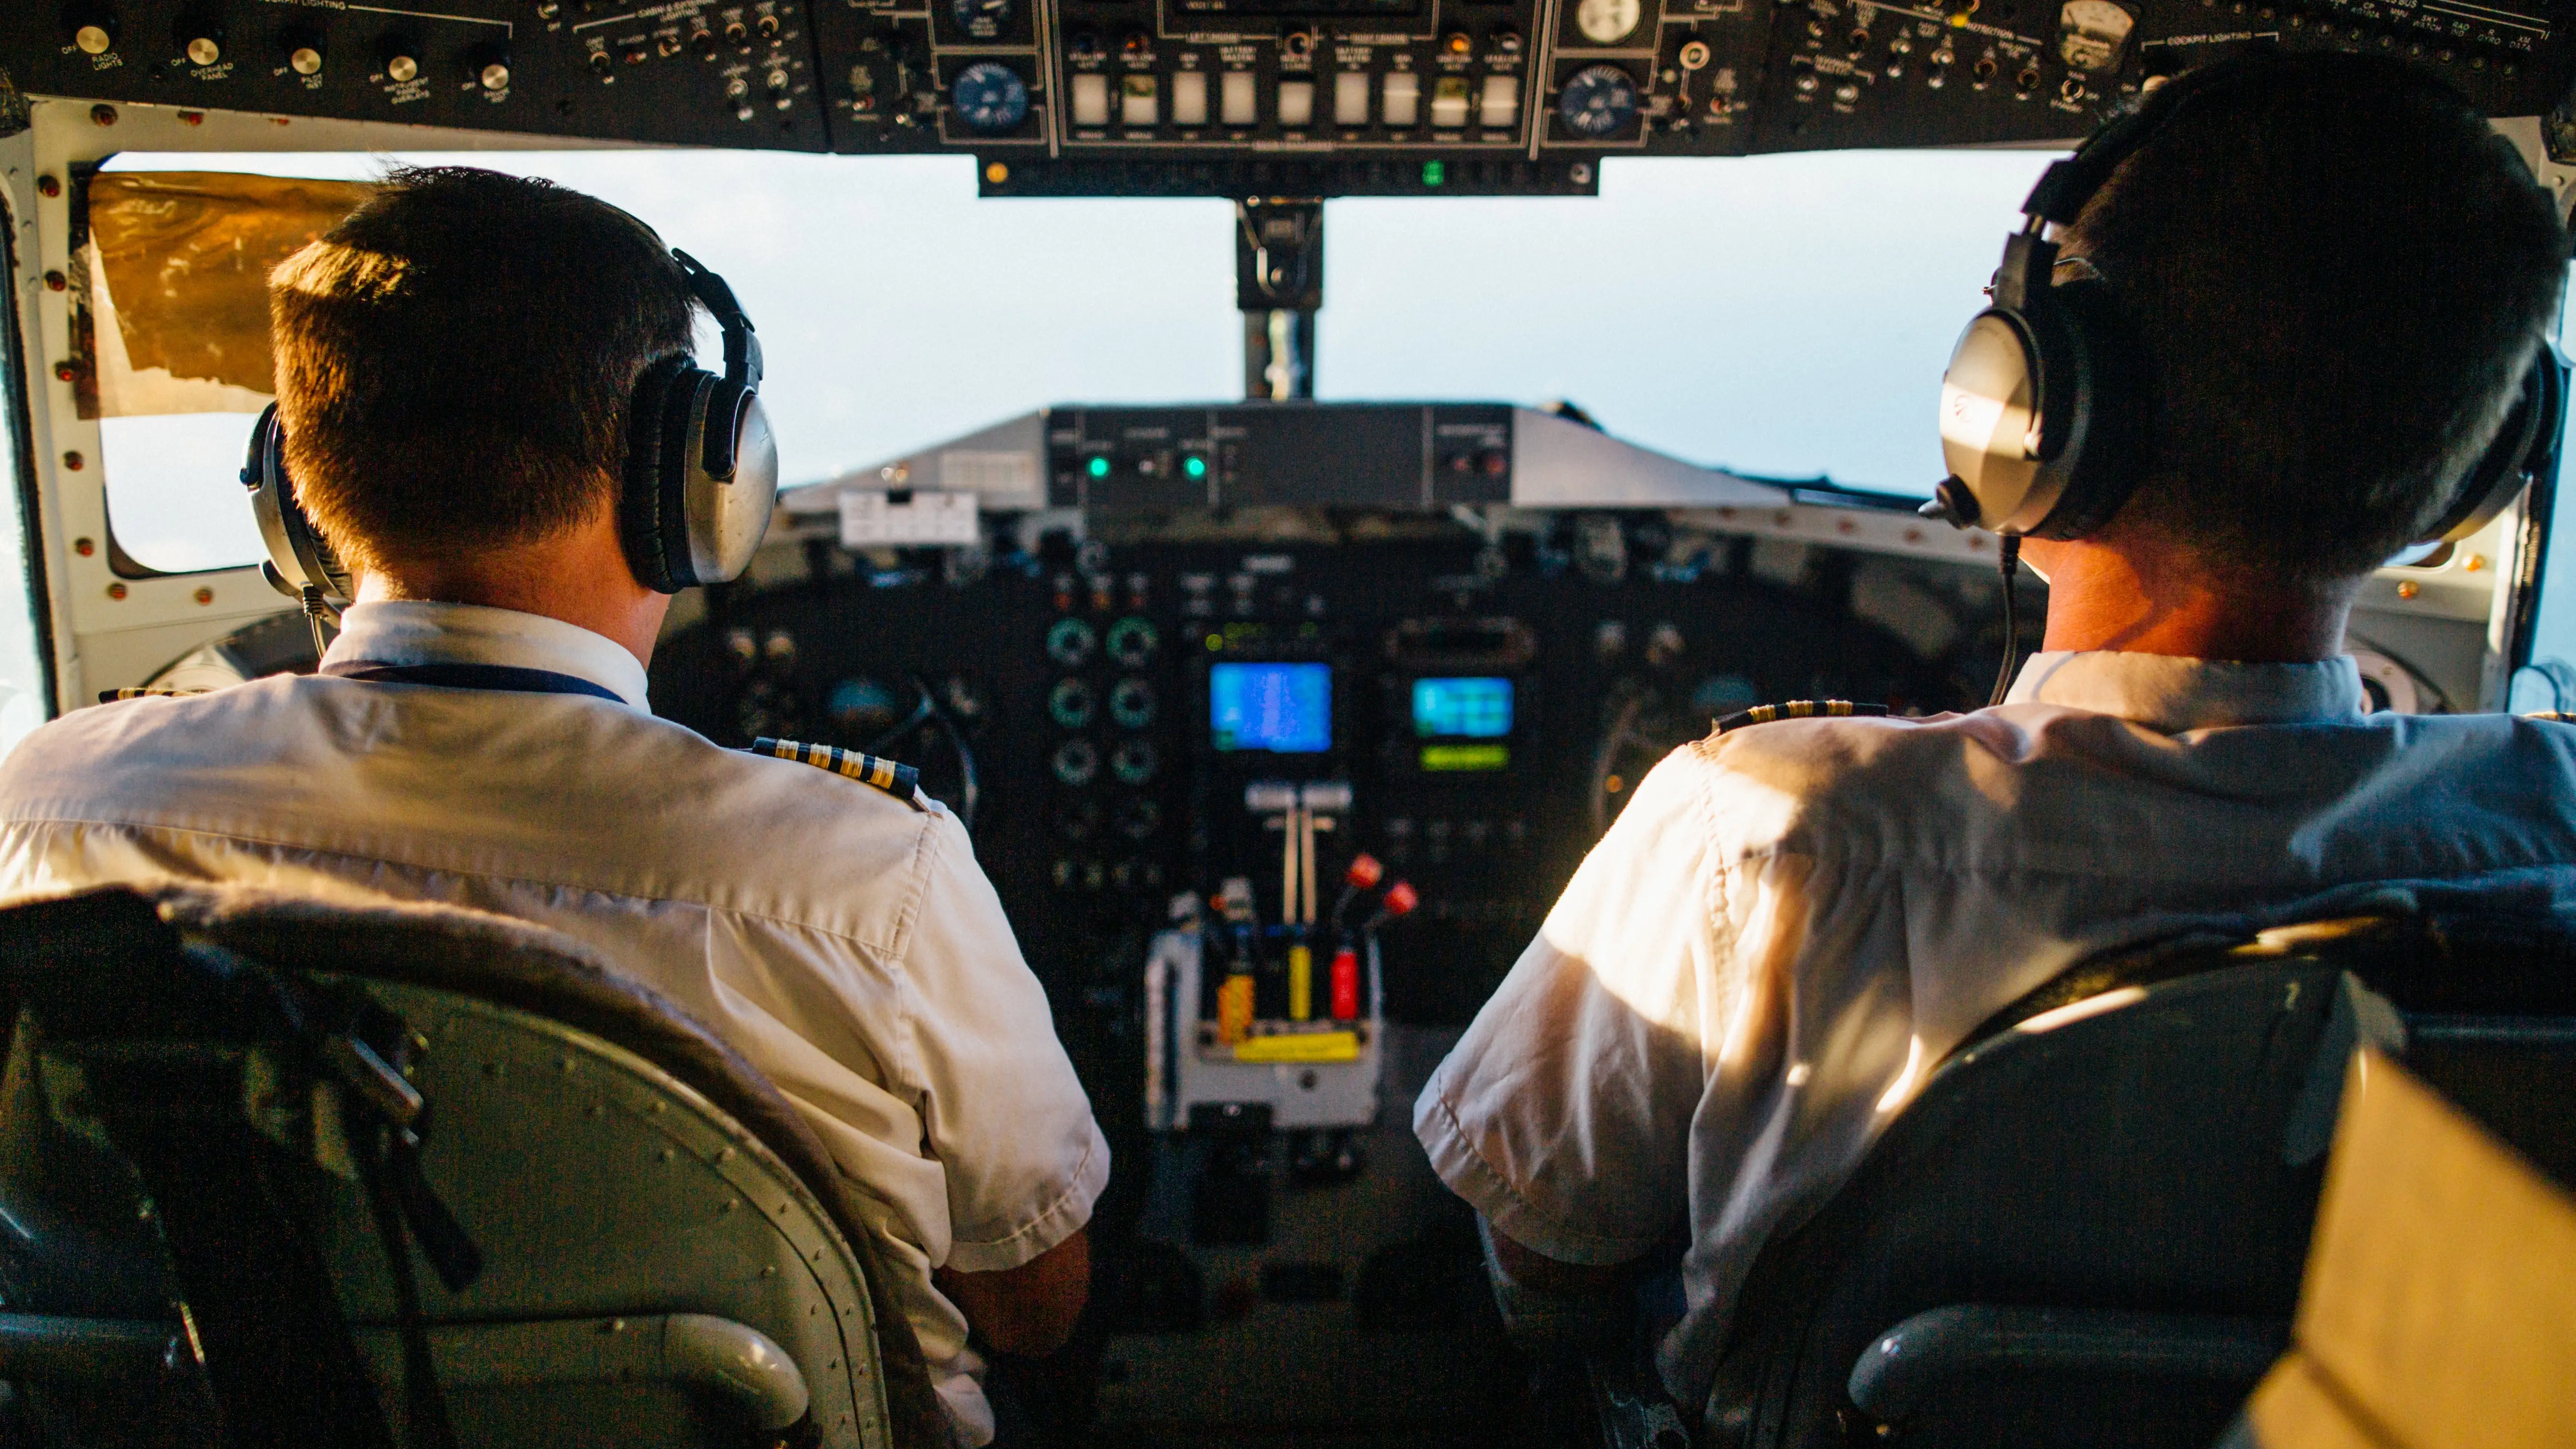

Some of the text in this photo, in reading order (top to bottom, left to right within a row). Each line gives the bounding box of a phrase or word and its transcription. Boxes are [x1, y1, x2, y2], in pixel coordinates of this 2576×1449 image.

[302, 0, 347, 10] LIGHTING
[2397, 0, 2417, 8] BUS
[2452, 21, 2471, 32] RAD
[61, 45, 78, 55] OFF
[92, 53, 118, 63] RADIO
[170, 57, 187, 67] OFF
[93, 58, 124, 72] LIGHTS
